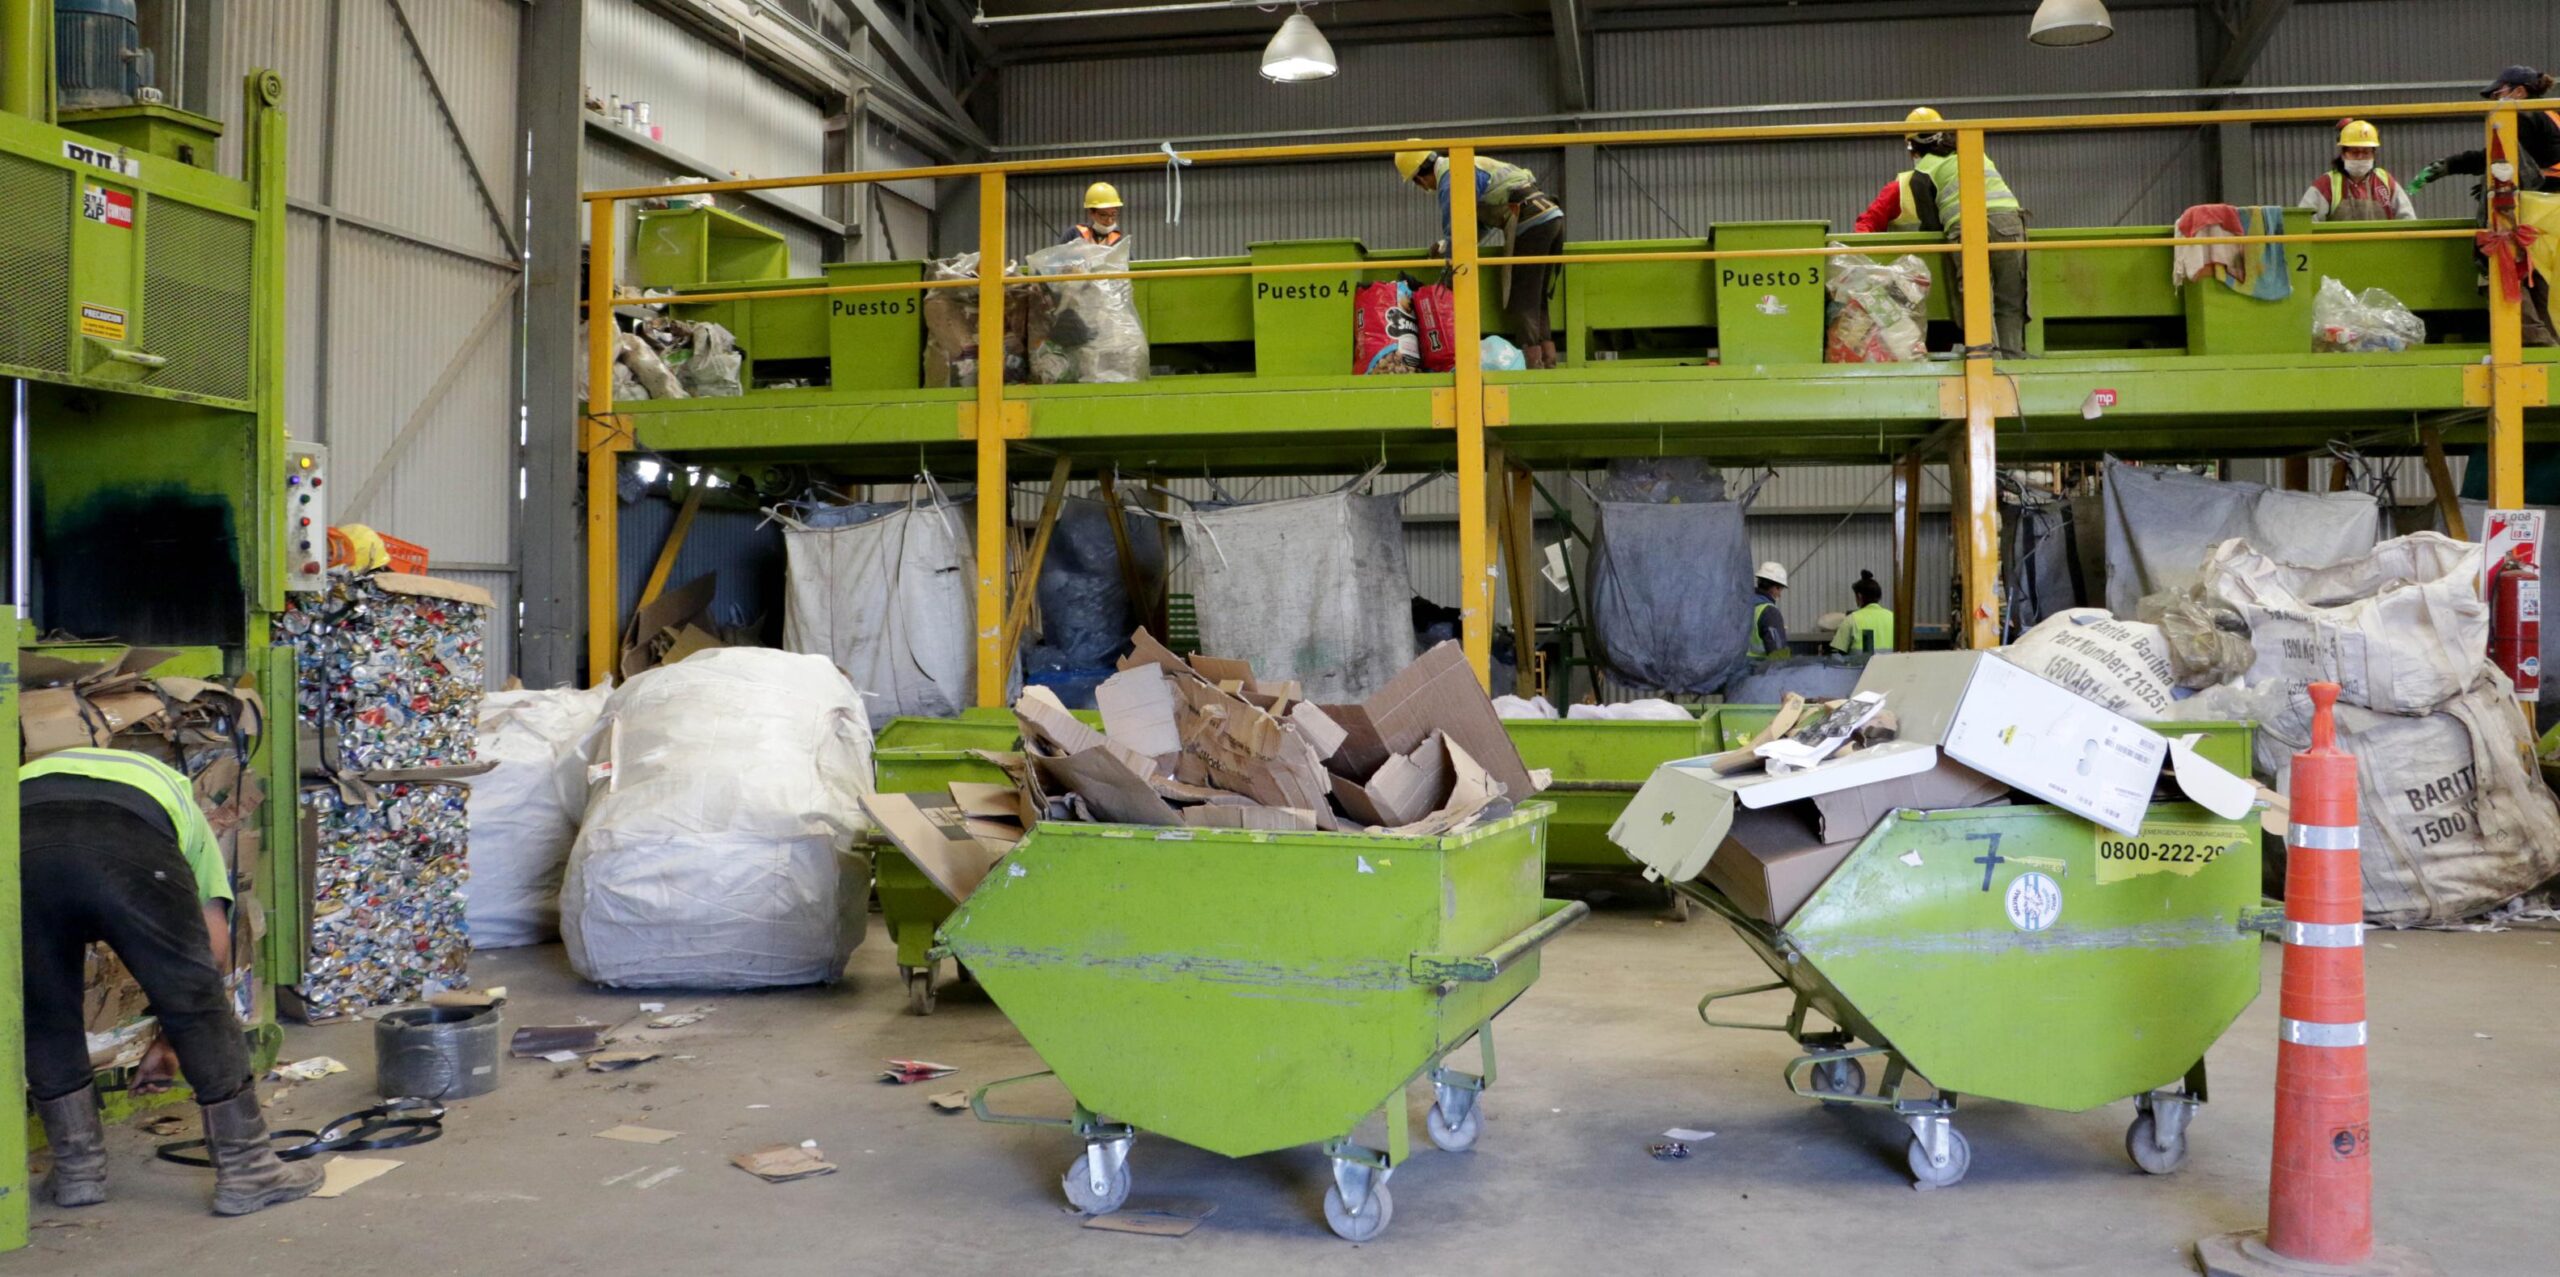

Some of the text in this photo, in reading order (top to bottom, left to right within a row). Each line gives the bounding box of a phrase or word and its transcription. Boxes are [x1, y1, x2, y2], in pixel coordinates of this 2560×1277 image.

[2296, 254, 2308, 271] 2
[1722, 266, 1819, 288] Puesto 3
[1257, 279, 1350, 300] Puesto 4
[833, 297, 916, 317] Puesto 5
[2048, 629, 2081, 648] Part
[2077, 639, 2131, 679] Number:
[2411, 811, 2467, 848] 1500
[1965, 832, 2005, 892] 7
